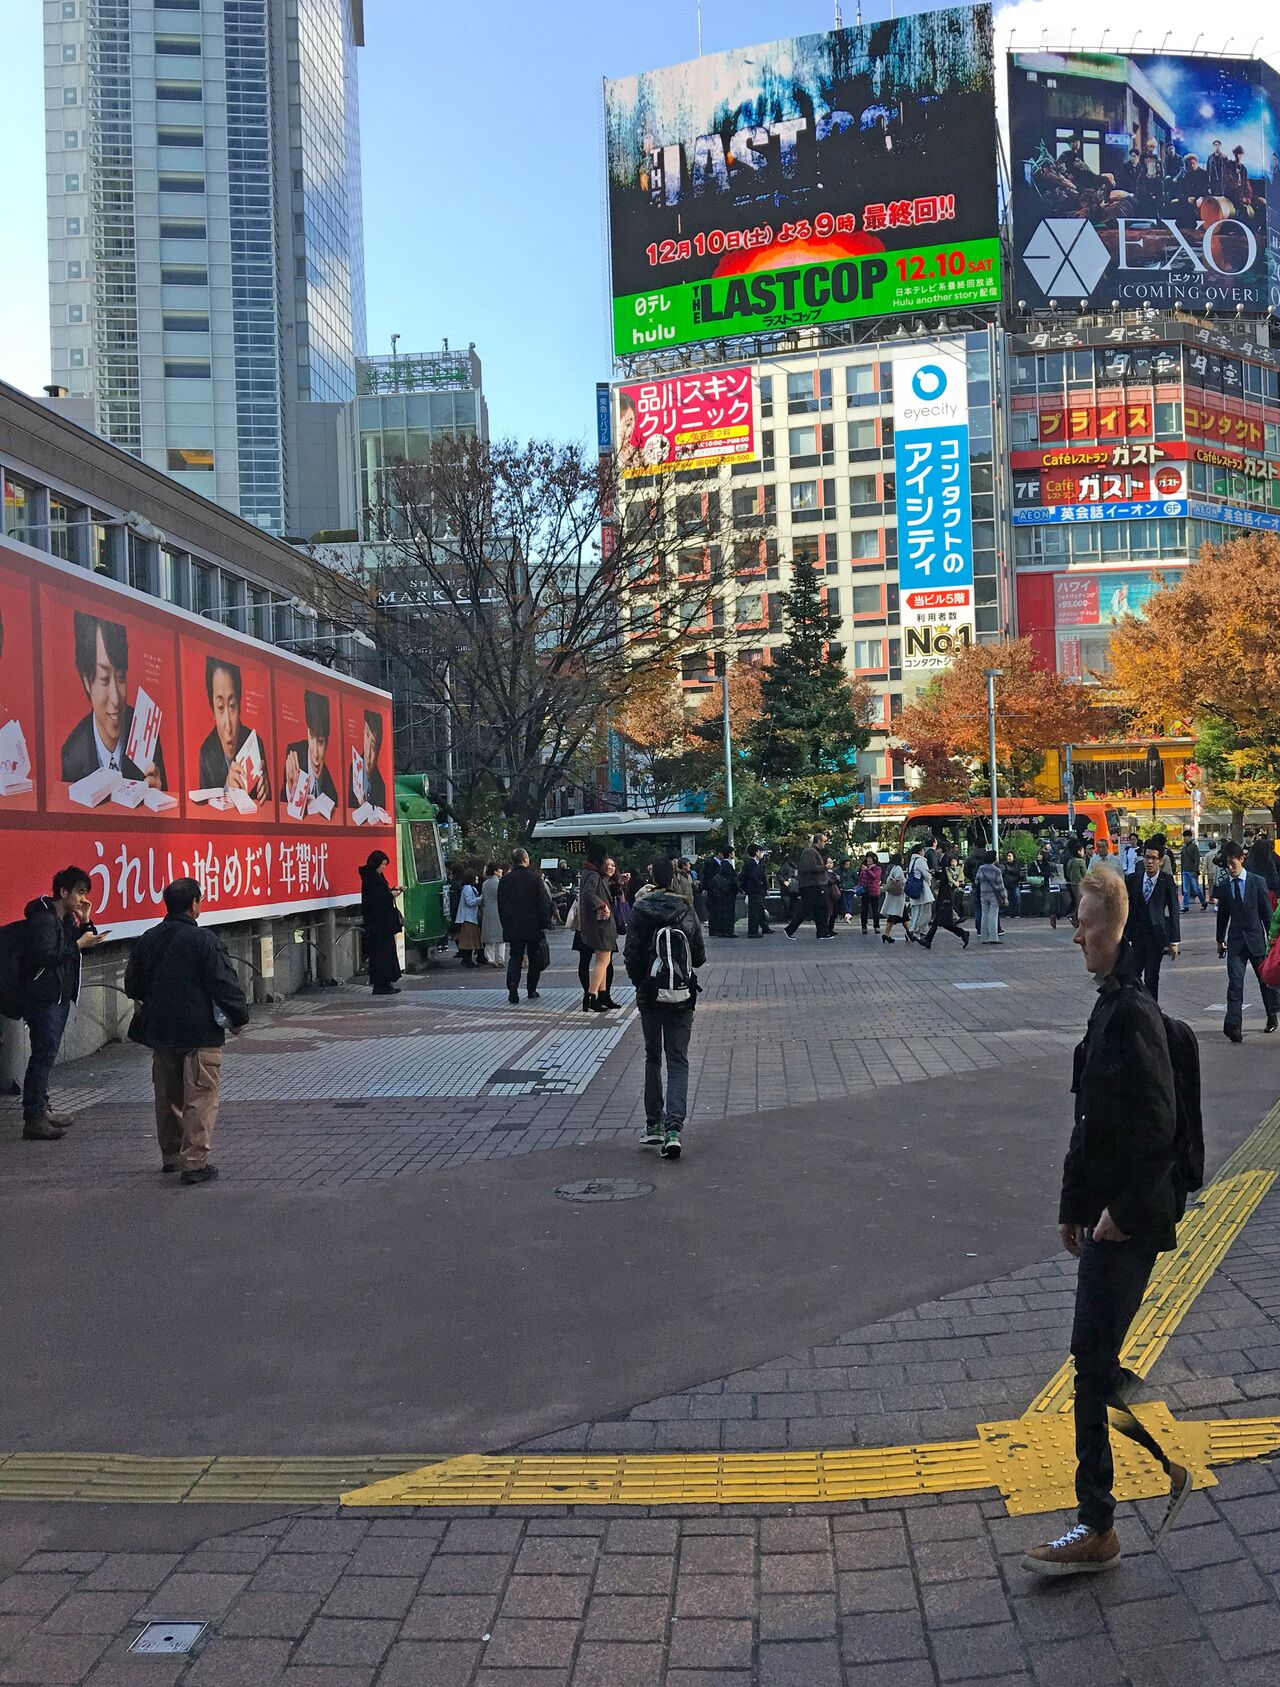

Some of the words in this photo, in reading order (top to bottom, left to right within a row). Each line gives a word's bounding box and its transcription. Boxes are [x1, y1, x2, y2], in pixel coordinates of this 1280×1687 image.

[646, 225, 773, 266] 12月10日(土)
[778, 211, 855, 241] よる9時
[863, 194, 956, 229] 最終回!!
[1117, 217, 1257, 276] EXO
[896, 250, 965, 282] 12.10
[968, 258, 993, 274] SAT
[701, 259, 888, 323] LASTCOP
[893, 299, 914, 308] Hulu
[916, 292, 952, 305] another
[954, 290, 979, 300] story
[980, 287, 997, 297] 配信
[896, 277, 994, 297] 日本テレビ系最終回放送
[762, 308, 822, 326] ラストコップ
[632, 324, 676, 346] hulu
[638, 375, 748, 412] 品川スキン
[639, 399, 749, 437] クリニック
[904, 402, 958, 420] eyecity
[1040, 406, 1151, 436] プライス
[1184, 407, 1262, 443] コンタクト
[1112, 444, 1164, 466] ガスト
[1244, 457, 1279, 479] ガスト
[1015, 481, 1040, 499] 7F
[1046, 477, 1074, 492] Café
[1078, 472, 1144, 502] ガスト
[904, 442, 935, 576] アイシティ
[940, 440, 964, 574] コンタクトの
[1018, 509, 1050, 523] AEON
[1165, 502, 1181, 514] 6F
[378, 590, 446, 603] MARK
[1057, 580, 1091, 592] ハワイ
[914, 592, 965, 606] 当ビル5階
[917, 612, 957, 622] 利用者数
[904, 623, 972, 657] No.1
[905, 658, 952, 667] コンタクトシ
[89, 841, 273, 914] うれしい始めだ!
[278, 841, 329, 894] 年賀状
